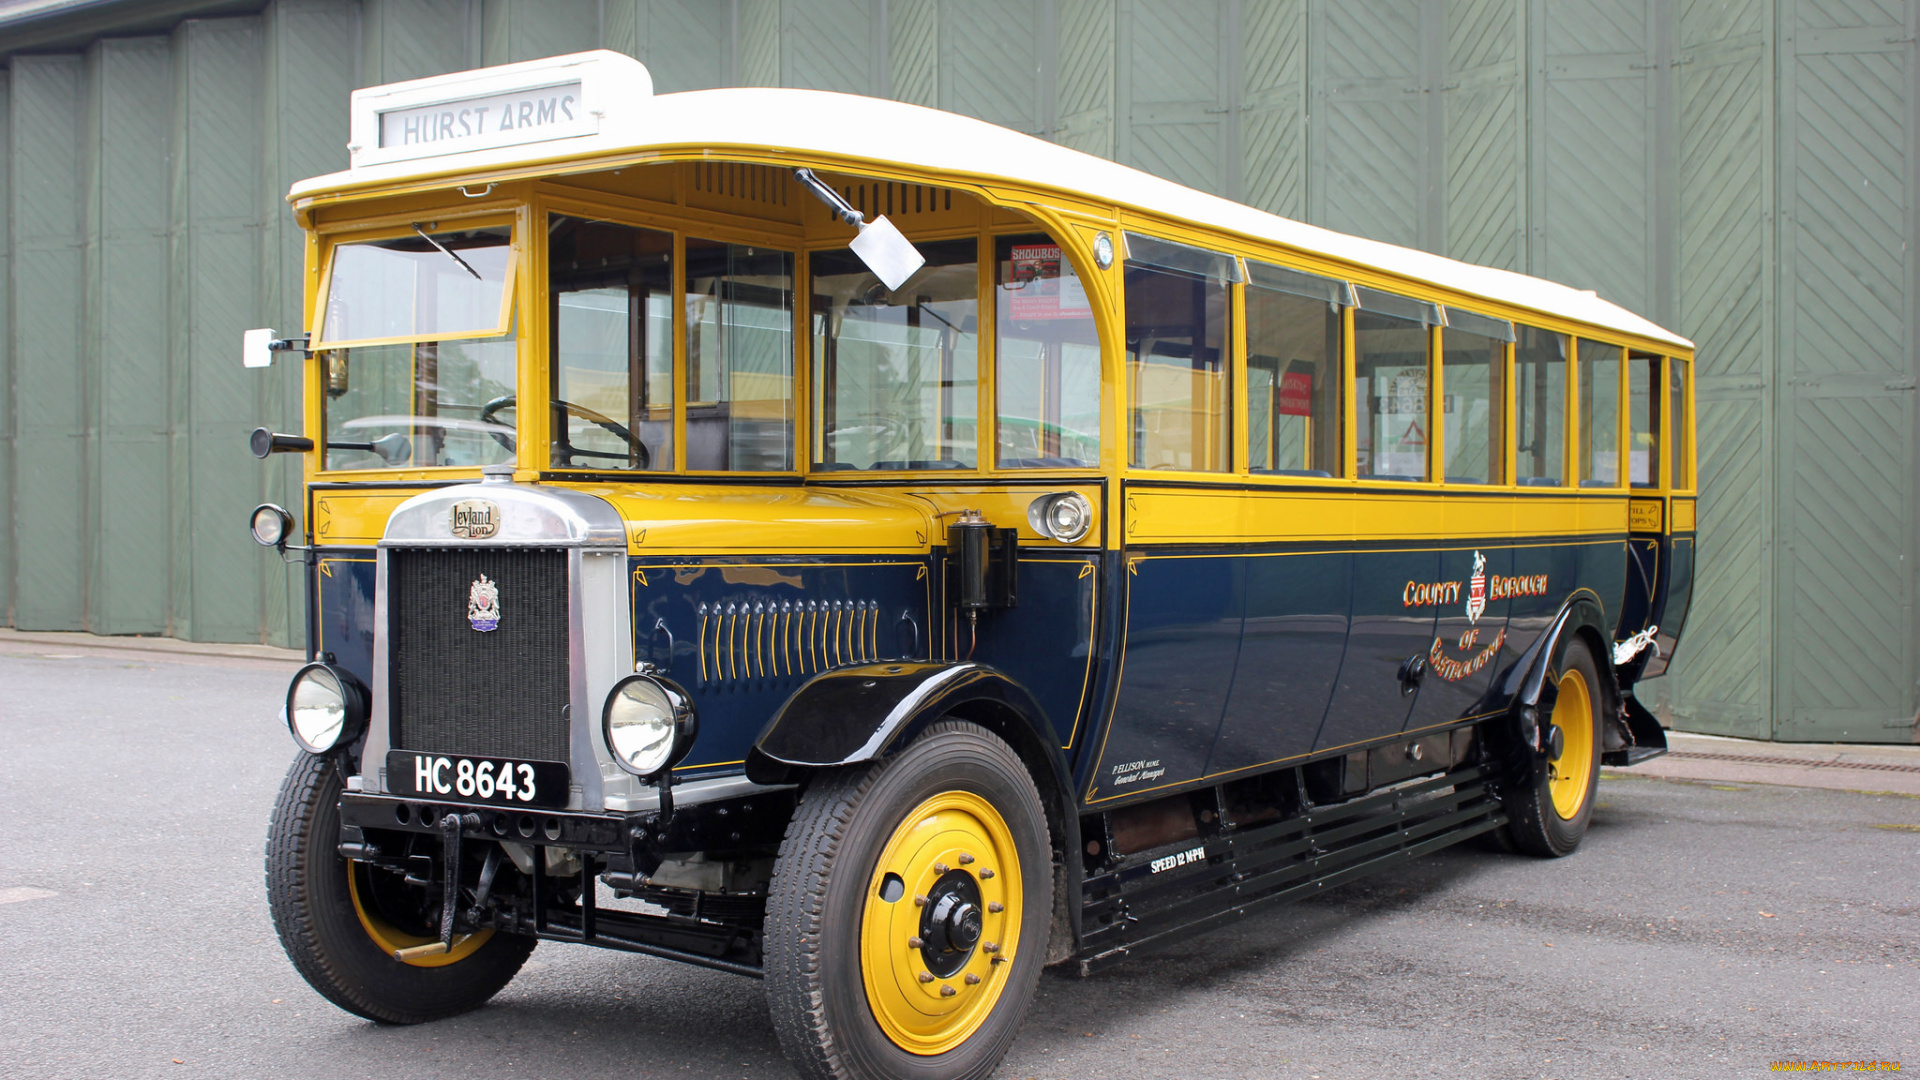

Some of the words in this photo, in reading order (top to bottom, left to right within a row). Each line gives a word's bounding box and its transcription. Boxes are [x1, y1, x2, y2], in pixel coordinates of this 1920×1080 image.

[404, 106, 489, 145] HURST
[499, 95, 575, 131] ARMS
[1012, 247, 1060, 260] SHOWBUS
[452, 505, 491, 530] Leyland
[468, 524, 494, 538] Lion
[1403, 581, 1462, 607] COUNTY
[1490, 574, 1548, 600] BOROUGH
[1459, 629, 1480, 650] OF
[414, 755, 452, 795] HC
[456, 758, 536, 801] 8643
[1151, 855, 1177, 874] SPEED
[1177, 852, 1186, 866] 12
